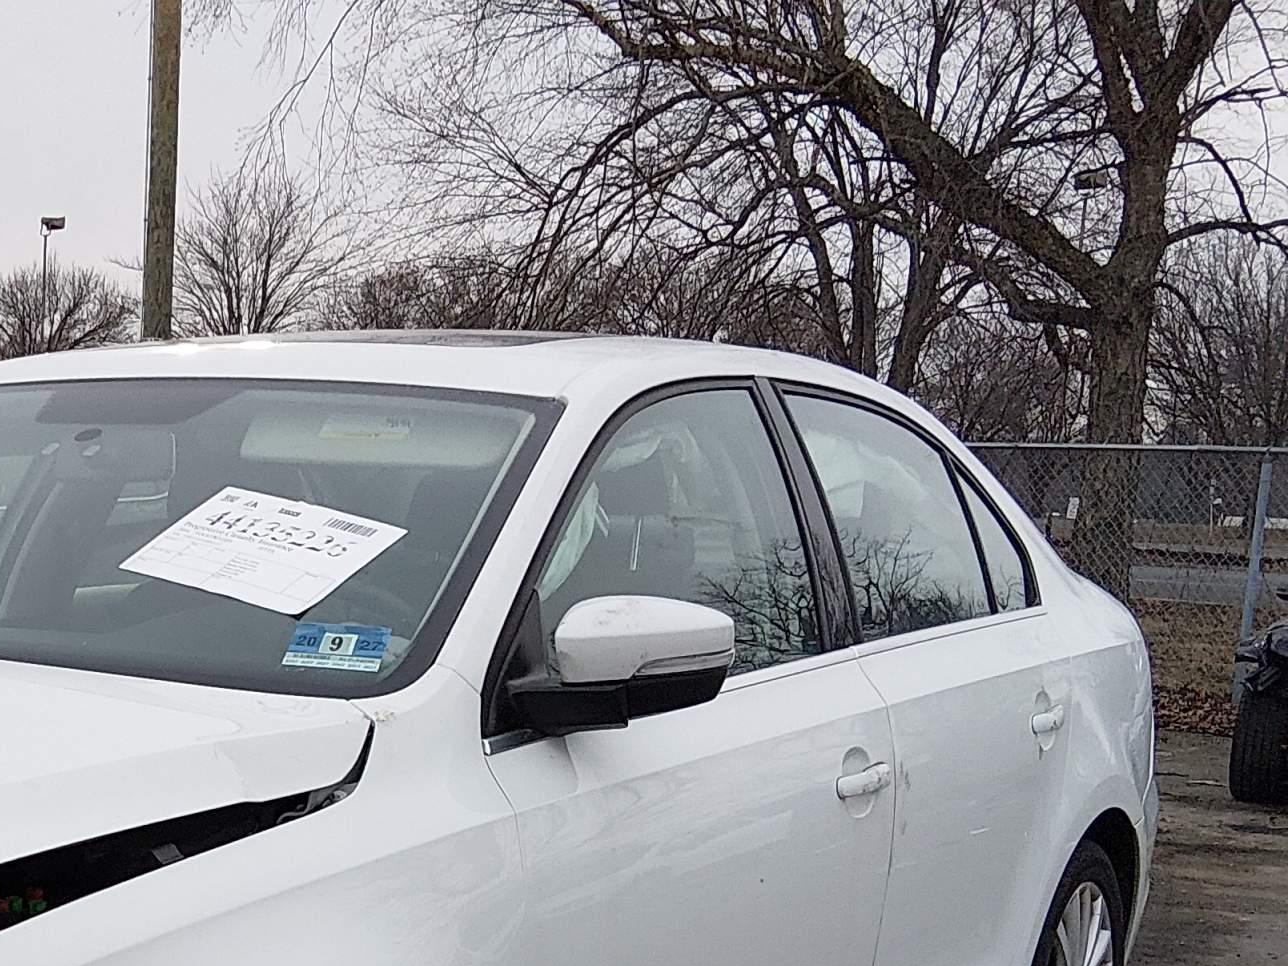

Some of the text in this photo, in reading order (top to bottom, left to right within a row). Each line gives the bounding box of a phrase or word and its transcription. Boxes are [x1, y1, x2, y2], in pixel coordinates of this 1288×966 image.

[205, 511, 358, 558] 44135226
[295, 635, 384, 652] 20 9 27
